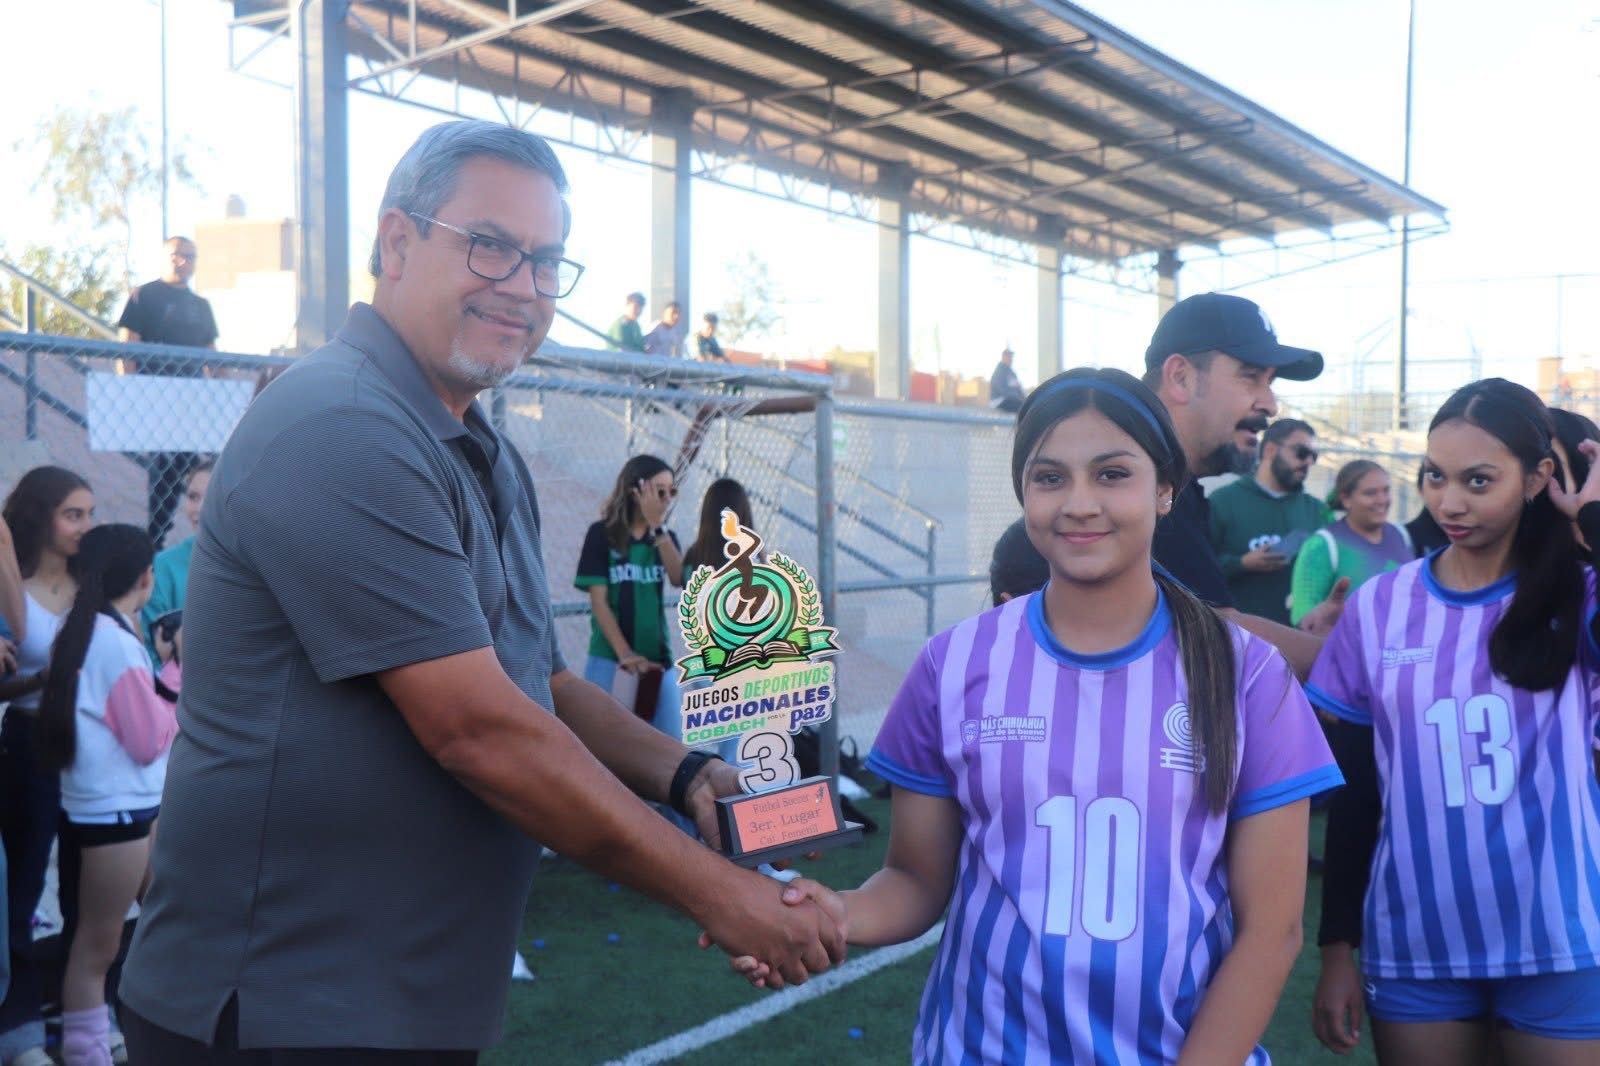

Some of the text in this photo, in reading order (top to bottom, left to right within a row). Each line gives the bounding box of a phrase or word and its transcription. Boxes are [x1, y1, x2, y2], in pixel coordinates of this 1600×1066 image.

[685, 665, 830, 711] JUEGOS DEPORTIVOS
[686, 685, 831, 730] NACIONALES
[686, 717, 766, 743] COBACH
[789, 704, 826, 730] paz
[981, 716, 1045, 731] MÁS CHIHUAHUA
[742, 731, 795, 794] 3
[1424, 693, 1516, 808] 13
[749, 807, 822, 834] 3er. Lugar
[1035, 795, 1141, 941] 10
